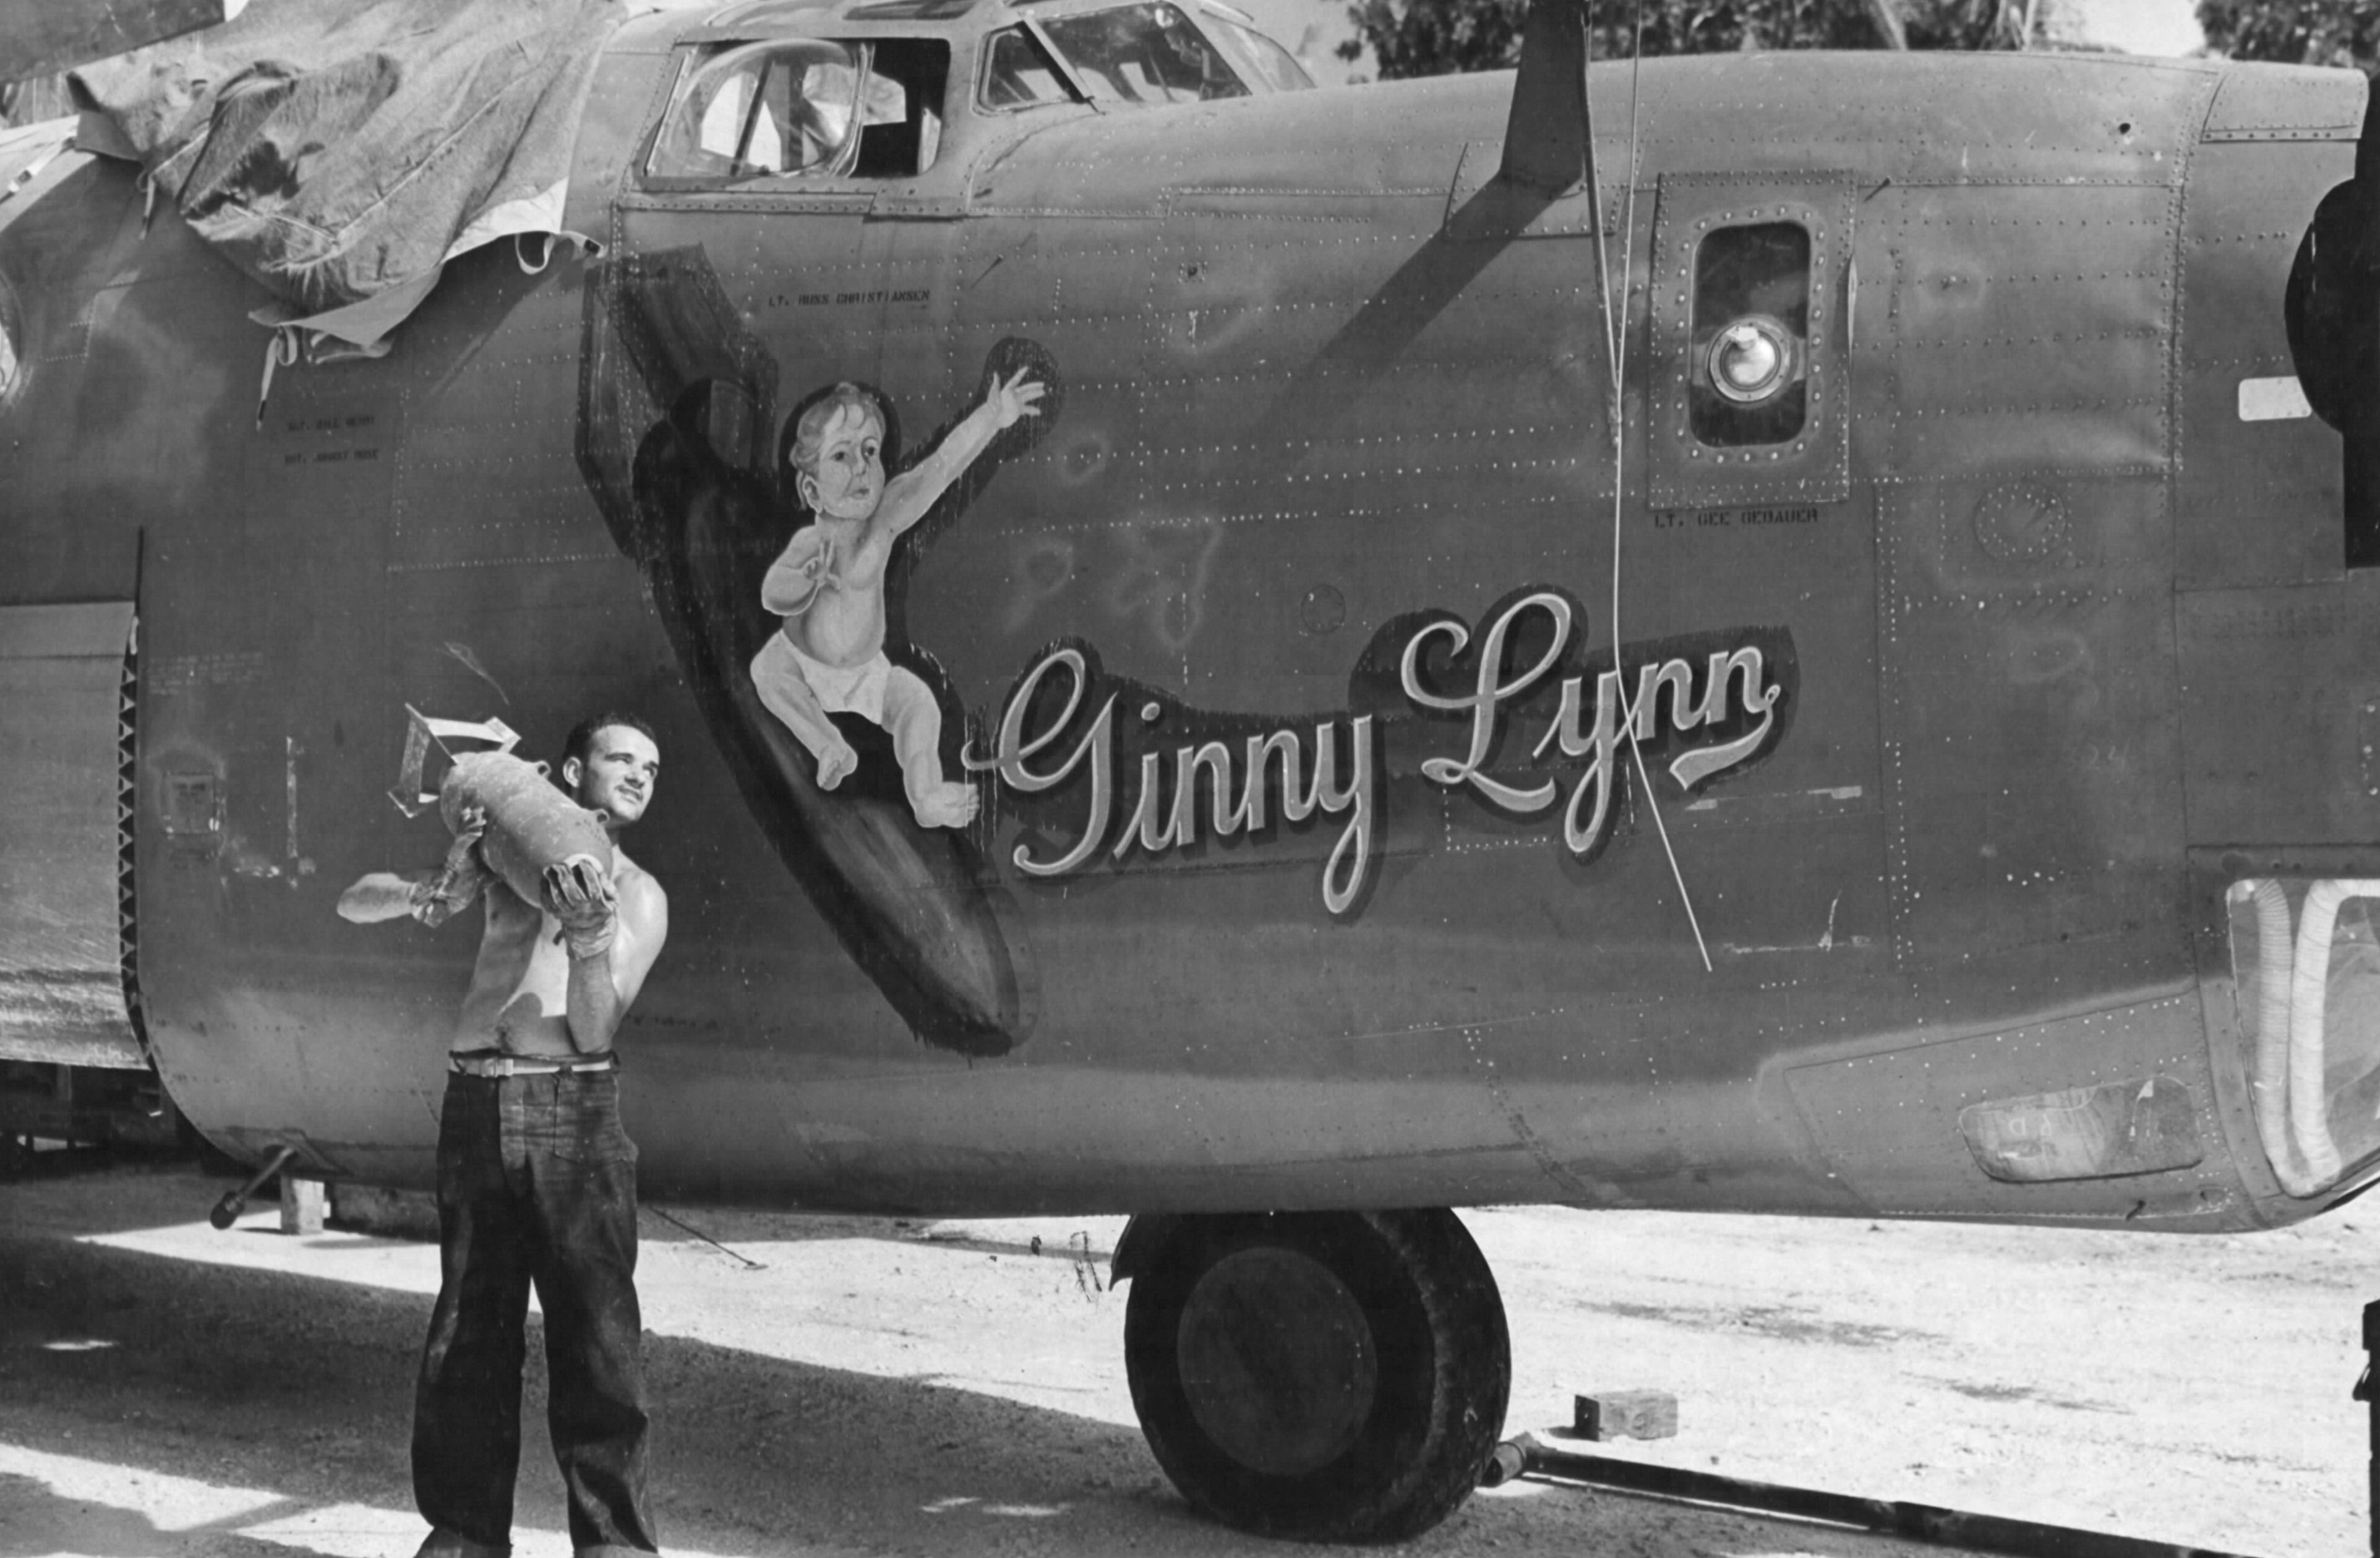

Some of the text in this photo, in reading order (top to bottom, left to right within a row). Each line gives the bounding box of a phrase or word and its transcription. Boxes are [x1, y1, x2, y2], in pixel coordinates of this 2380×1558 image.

[769, 295, 789, 307] LT.
[1655, 514, 1684, 528] LT.
[961, 593, 1781, 914] Ginny Lynn
